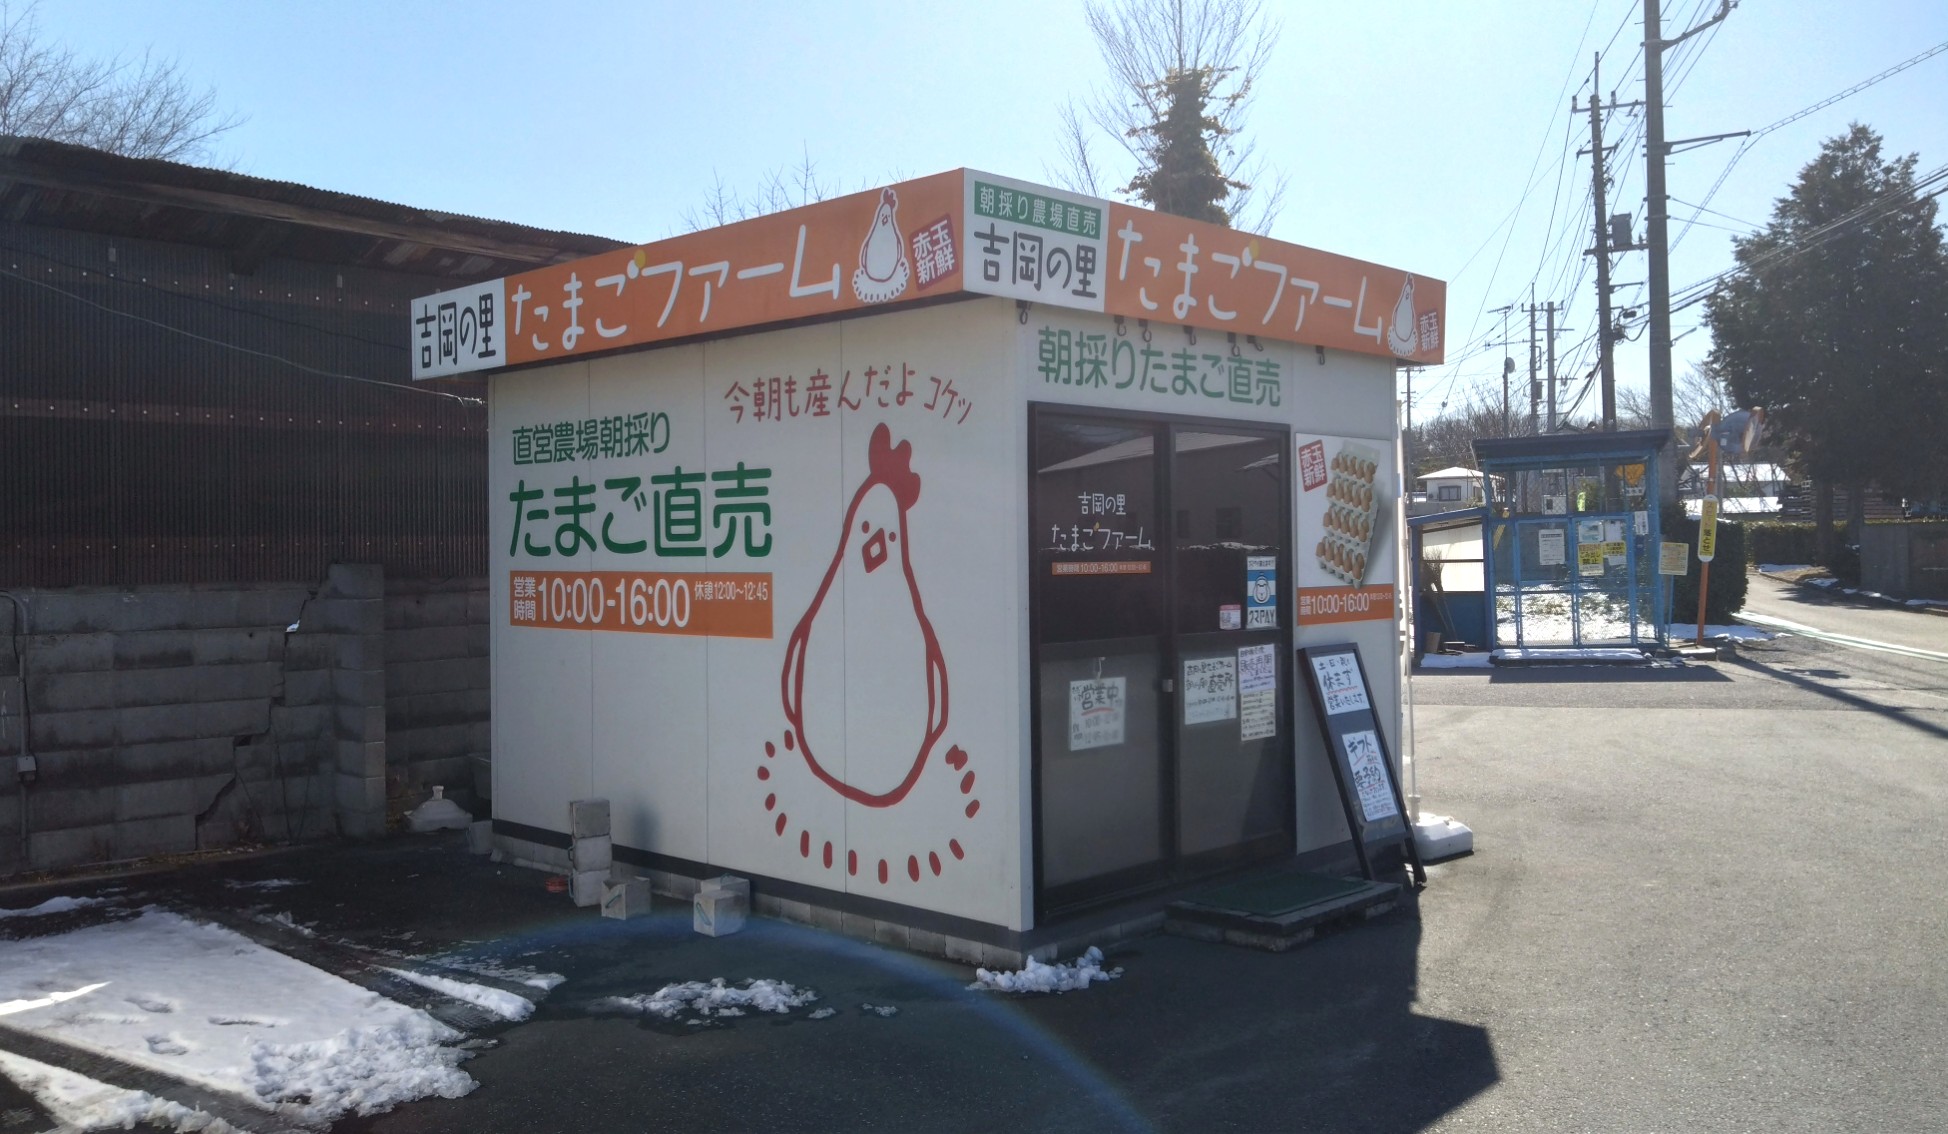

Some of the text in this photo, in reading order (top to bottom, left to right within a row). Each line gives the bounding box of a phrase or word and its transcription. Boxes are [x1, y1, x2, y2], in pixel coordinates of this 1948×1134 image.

[980, 186, 1097, 236] 朝採り農場直売
[913, 219, 951, 260] 赤玉
[916, 245, 955, 284] 新鮮
[974, 222, 1097, 299] 吉岡の里
[511, 225, 840, 350] たまごファーム
[1118, 220, 1382, 345] たまごファーム
[415, 293, 496, 368] 吉岡の里
[1420, 312, 1438, 331] 赤玉
[1038, 325, 1281, 407] 朝採りたまご直売
[724, 362, 972, 424] 今朝も産んだよ コケッ
[512, 412, 670, 465] 直営農場朝採り
[1301, 443, 1323, 467] 赤玉
[509, 461, 773, 559] たまご直売
[1078, 491, 1126, 515] 吉岡の里
[1051, 522, 1151, 552] たまごファーム
[514, 577, 536, 598] 営業
[538, 577, 690, 628] 10:00-16:00
[1311, 592, 1370, 615] 10:00-16:00
[514, 600, 536, 621] 時間
[1081, 682, 1120, 711] 営業中
[1323, 669, 1353, 691] 休まず
[1347, 734, 1372, 759] ギフト
